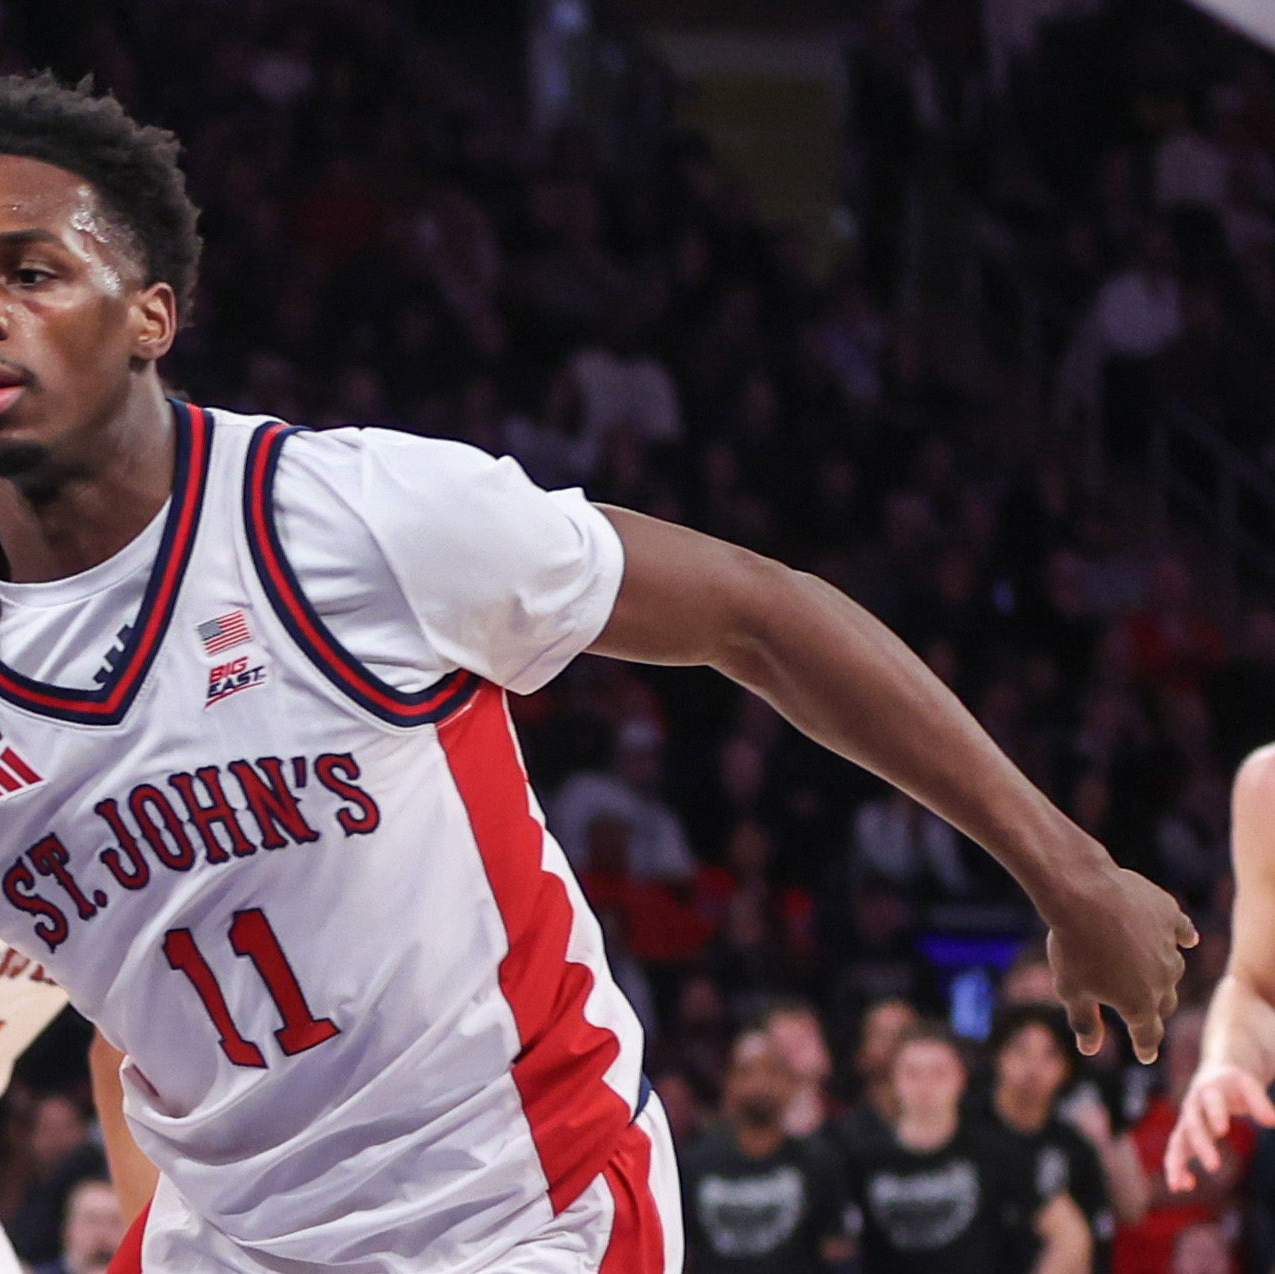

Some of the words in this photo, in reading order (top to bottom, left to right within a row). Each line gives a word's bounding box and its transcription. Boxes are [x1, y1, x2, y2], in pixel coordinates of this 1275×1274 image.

[207, 666, 265, 699] EAST
[209, 656, 248, 684] BIG
[1, 833, 107, 952] ST.
[95, 752, 380, 890] JOHN'S
[161, 908, 340, 1068] 11
